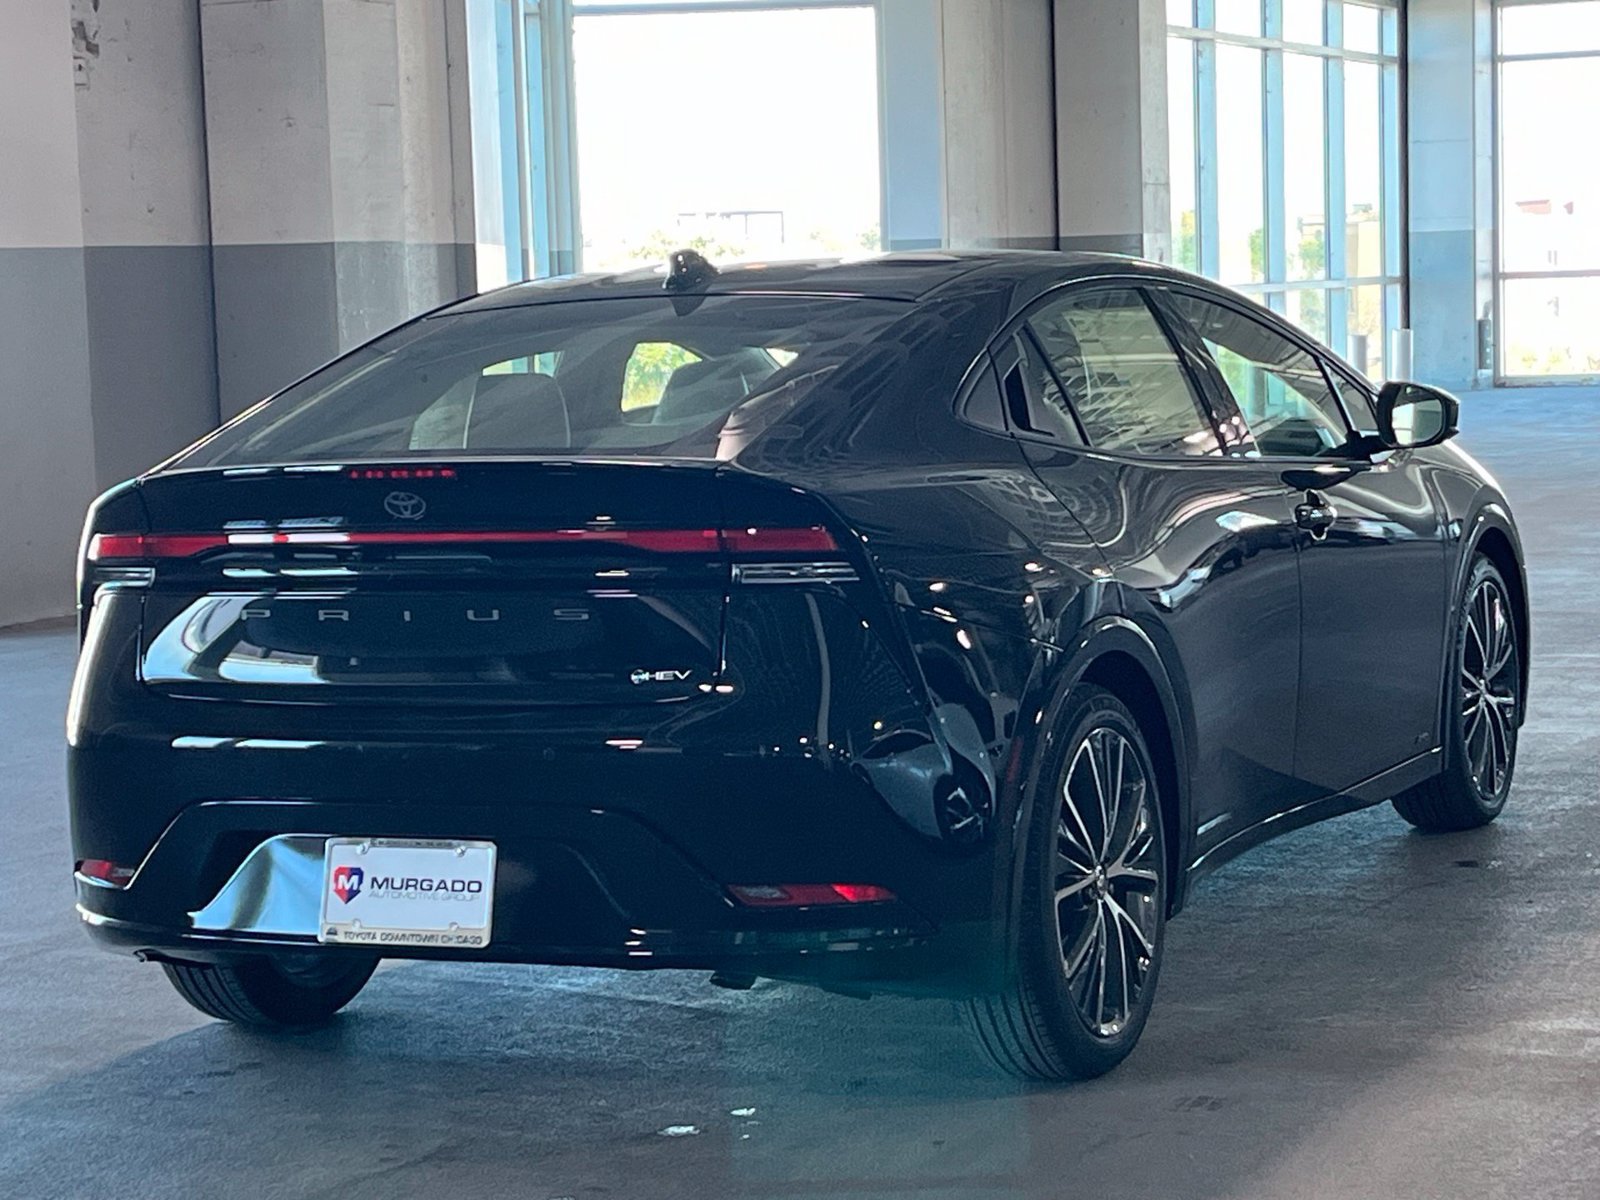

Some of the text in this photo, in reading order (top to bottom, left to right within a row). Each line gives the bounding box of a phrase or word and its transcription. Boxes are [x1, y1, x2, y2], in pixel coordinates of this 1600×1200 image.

[241, 608, 590, 622] PRIUS
[655, 669, 693, 681] HEV
[370, 877, 482, 893] MURGADO
[368, 891, 480, 902] AUTOMOTIVE GROUP
[344, 931, 377, 941] TOYOTA
[380, 931, 439, 943] DOWNTOWN
